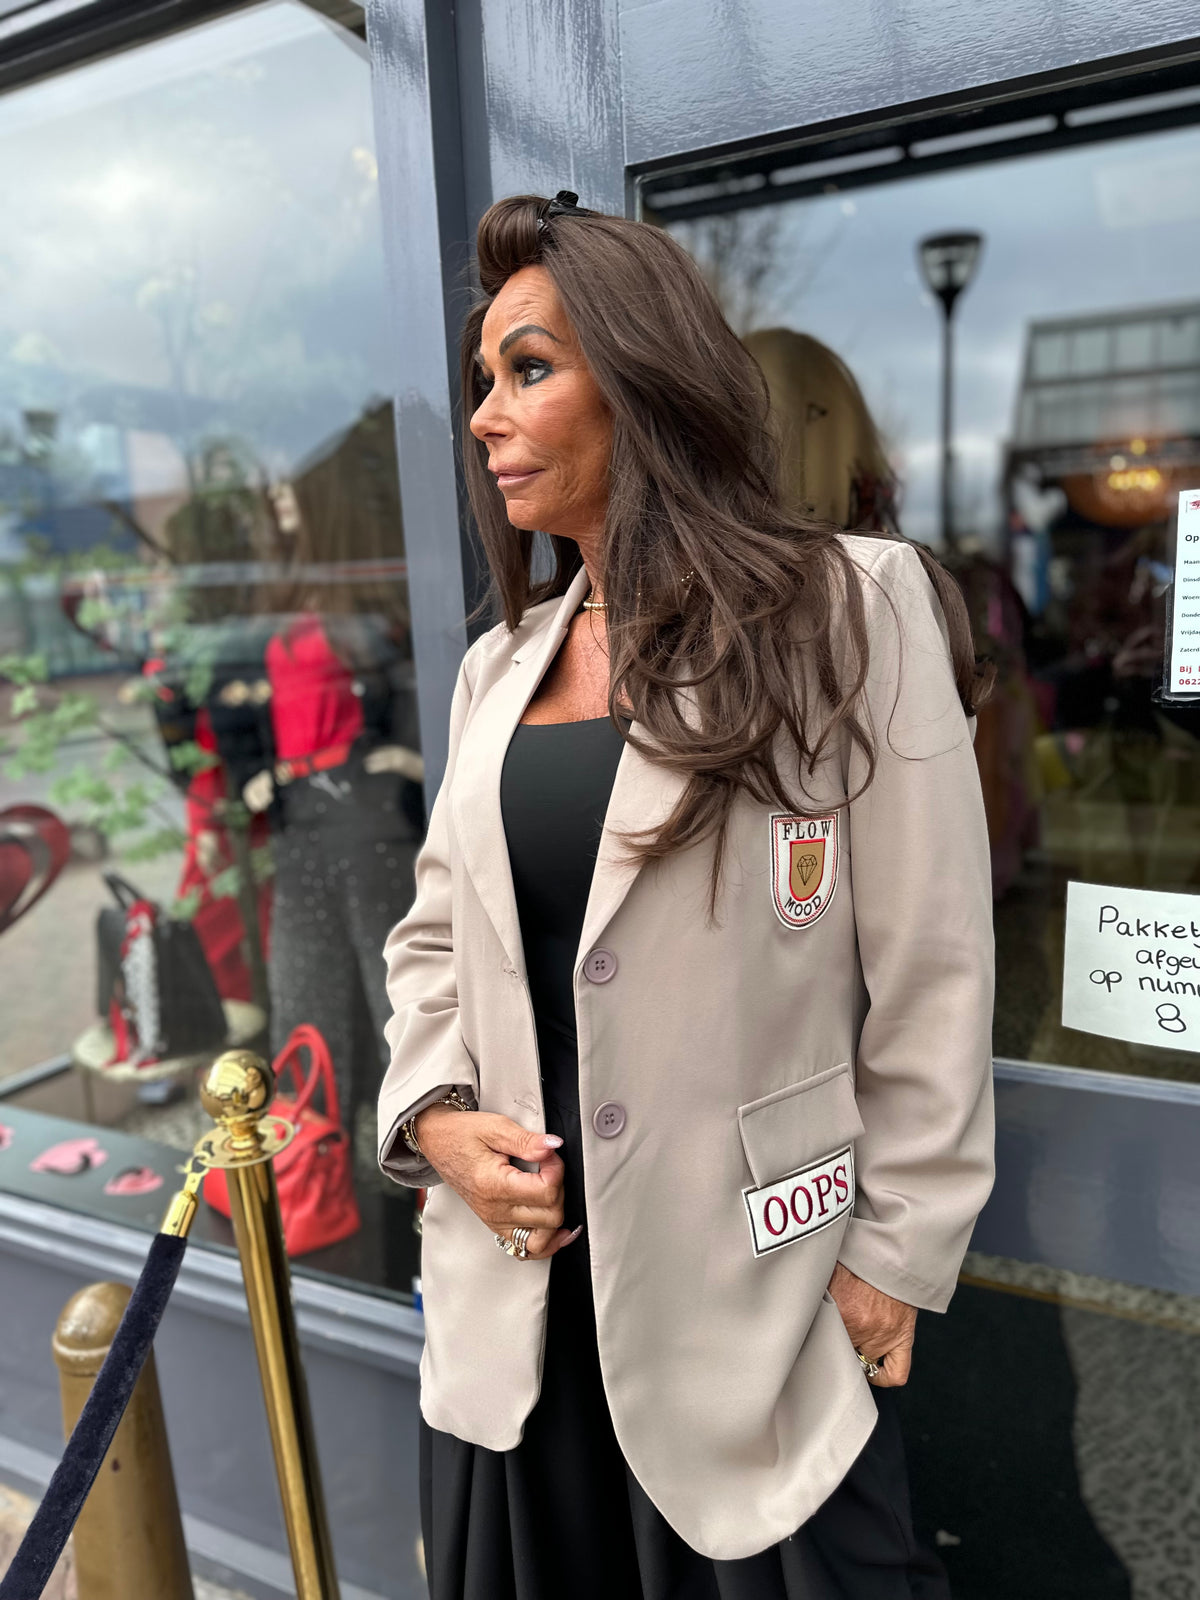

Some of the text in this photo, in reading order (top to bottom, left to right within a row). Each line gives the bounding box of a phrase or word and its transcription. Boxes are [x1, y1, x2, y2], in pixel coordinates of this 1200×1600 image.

[1185, 534, 1200, 543] Op
[1179, 665, 1192, 674] Bij
[782, 820, 832, 841] FLOW
[784, 895, 822, 917] MOOD
[1089, 969, 1200, 998] op num
[1155, 1003, 1187, 1033] 8
[763, 1164, 849, 1236] OOPS
